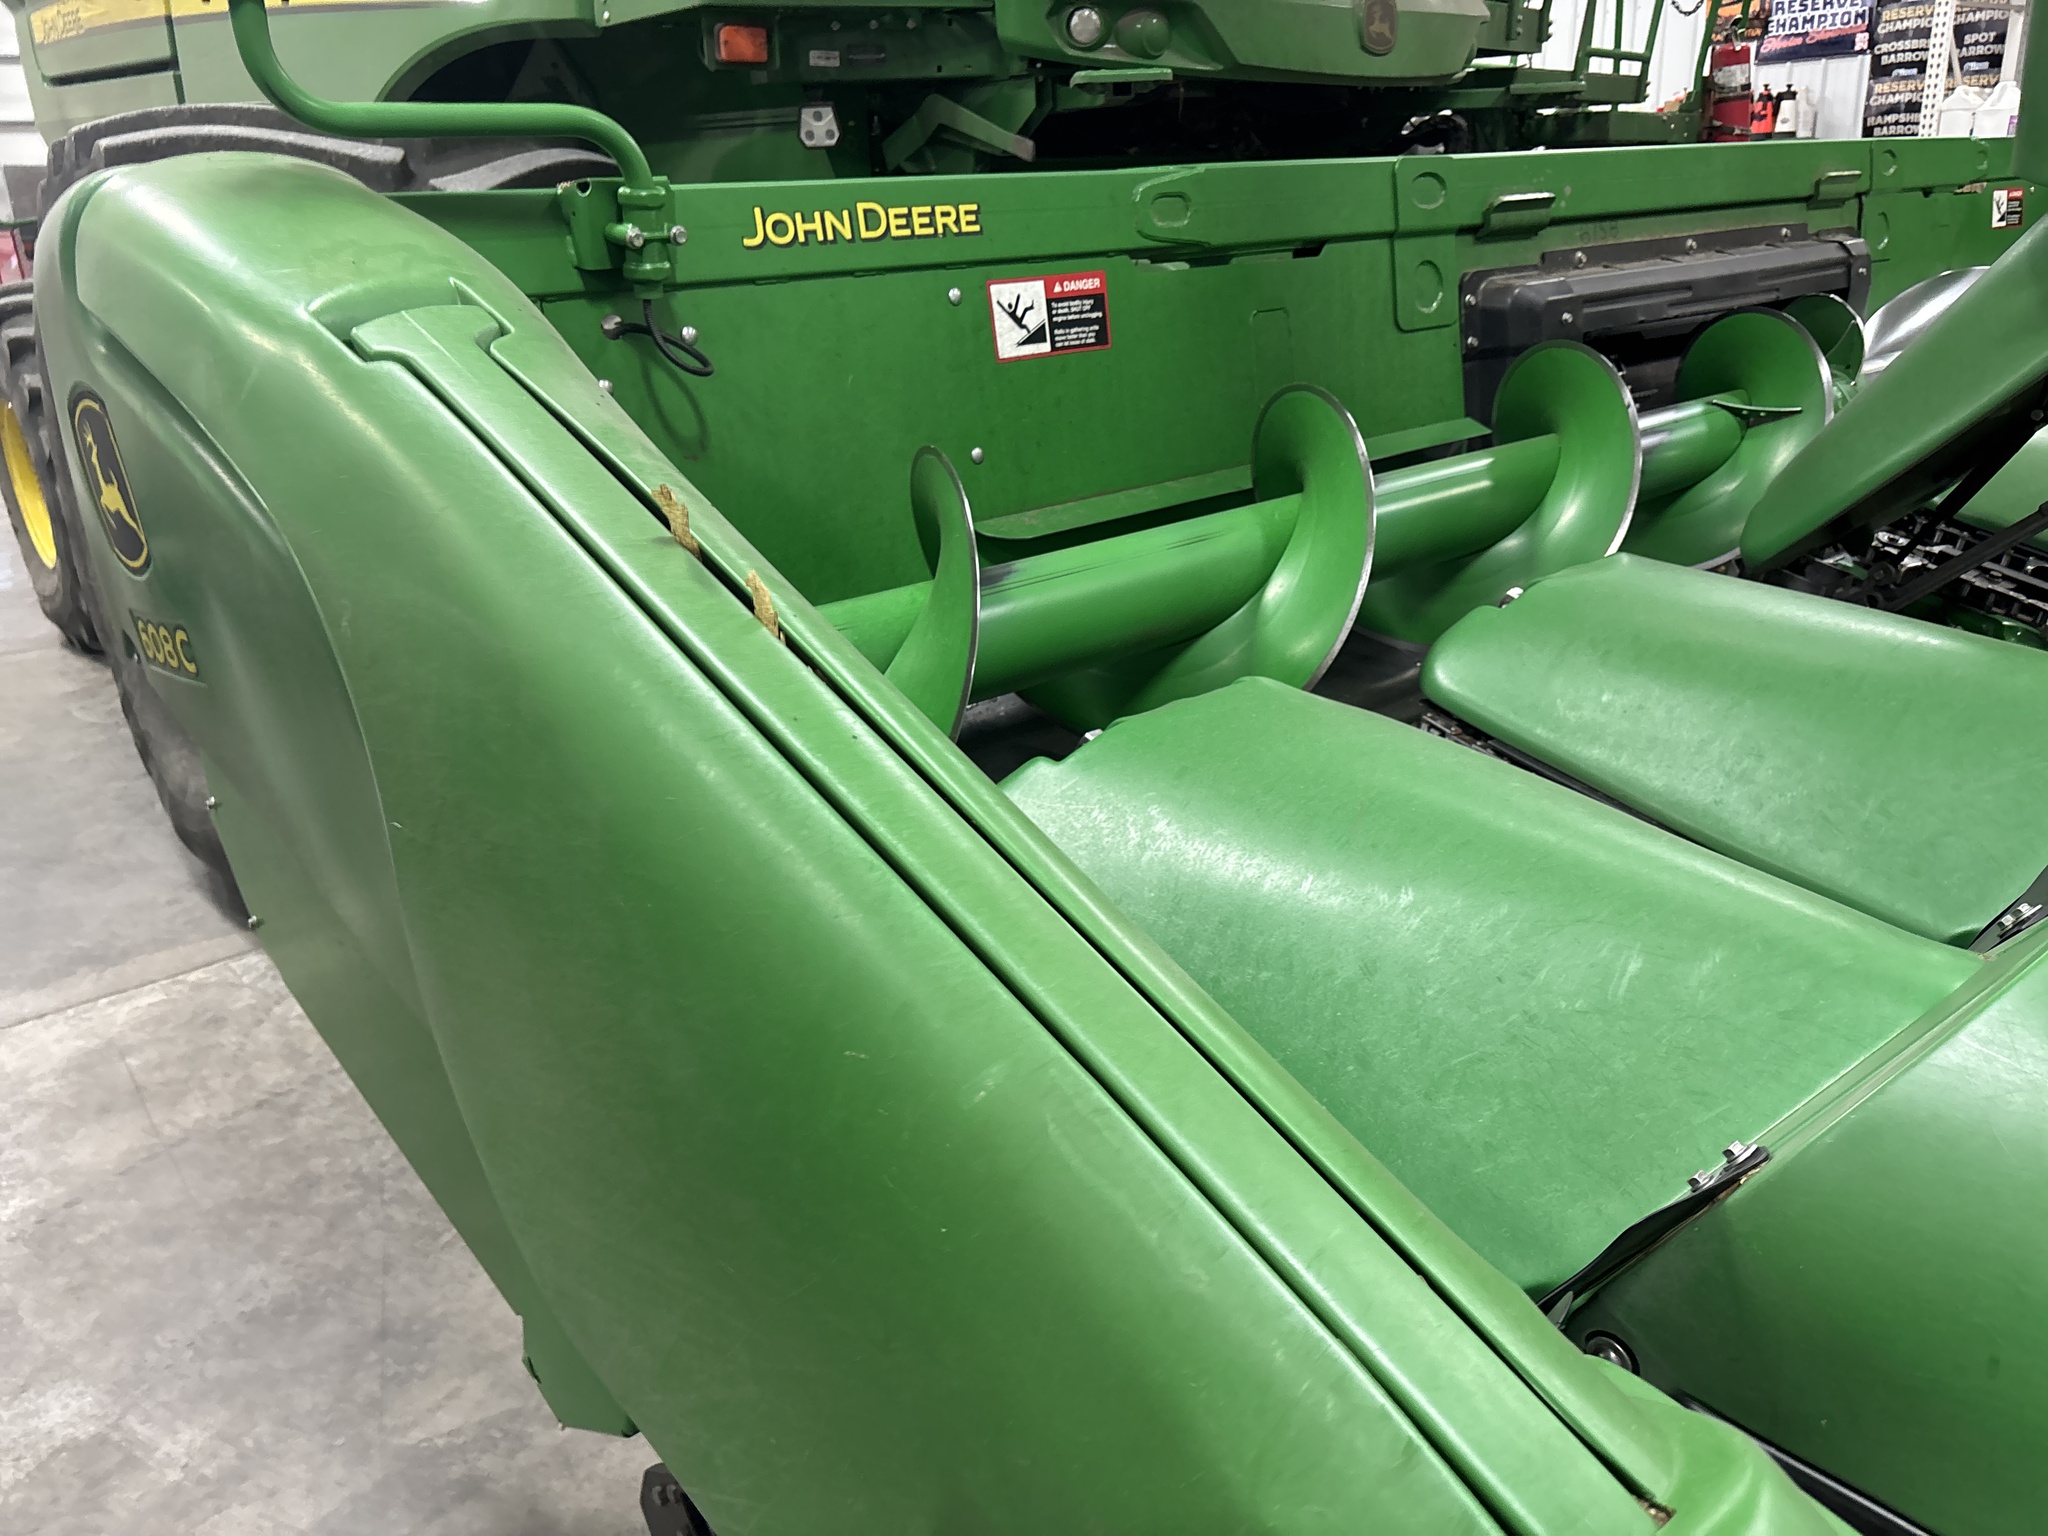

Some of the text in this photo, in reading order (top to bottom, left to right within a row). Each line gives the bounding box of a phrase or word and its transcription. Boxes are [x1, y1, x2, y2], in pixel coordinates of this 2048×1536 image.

[1882, 4, 1935, 21] RESERV
[1953, 9, 2010, 25] HAMPIO
[1877, 17, 1933, 34] CHAMPIO
[1874, 38, 1930, 55] CROSSBR
[1963, 31, 1997, 46] SPOT
[1957, 44, 2005, 59] ARROW
[1874, 79, 1925, 95] RESERV
[1869, 91, 1923, 106] CHAMPIO
[1867, 112, 1921, 127] HAMPSHI
[743, 201, 982, 248] JOHN DEERE
[1063, 277, 1101, 292] DANGER
[137, 618, 198, 674] 608C
